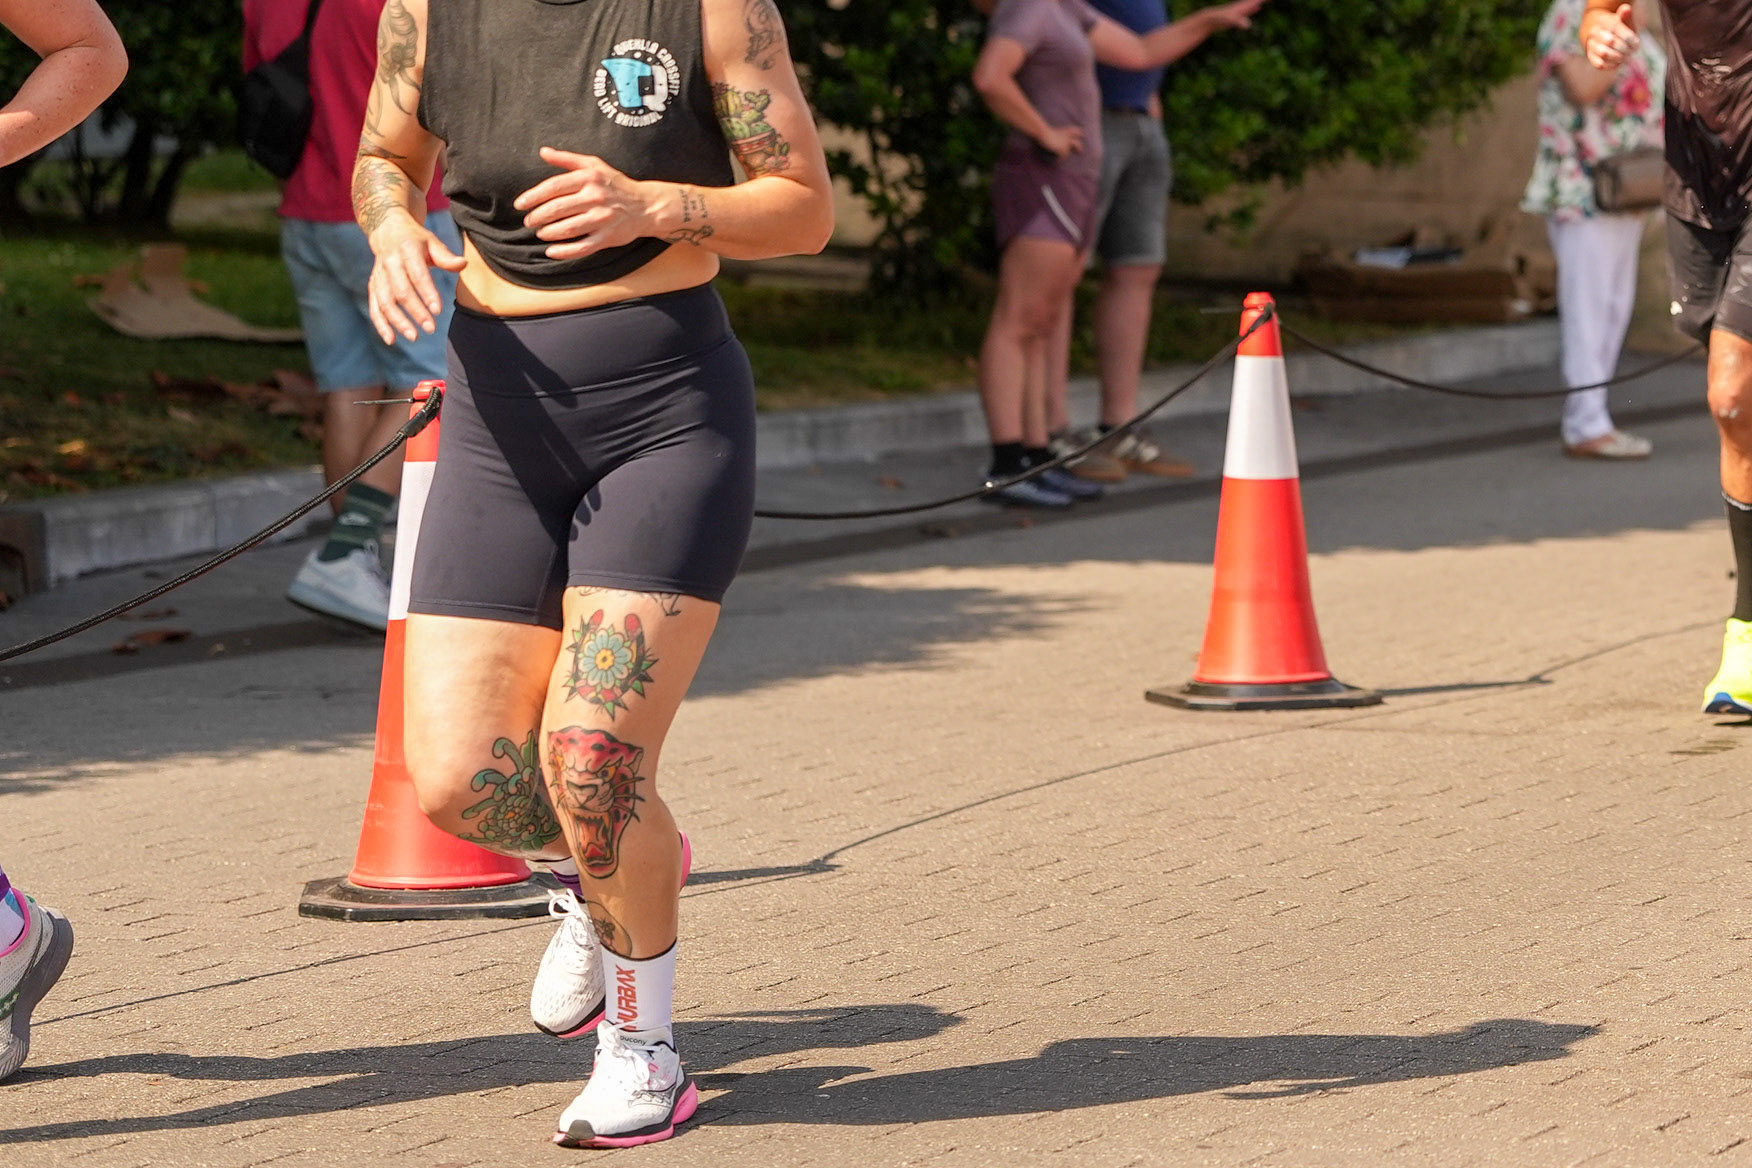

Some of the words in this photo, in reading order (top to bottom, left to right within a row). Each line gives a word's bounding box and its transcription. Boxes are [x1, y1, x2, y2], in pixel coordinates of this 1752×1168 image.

[656, 47, 680, 96] CROSSFIT
[597, 97, 618, 119] LIFT
[620, 1035, 648, 1046] aucony
